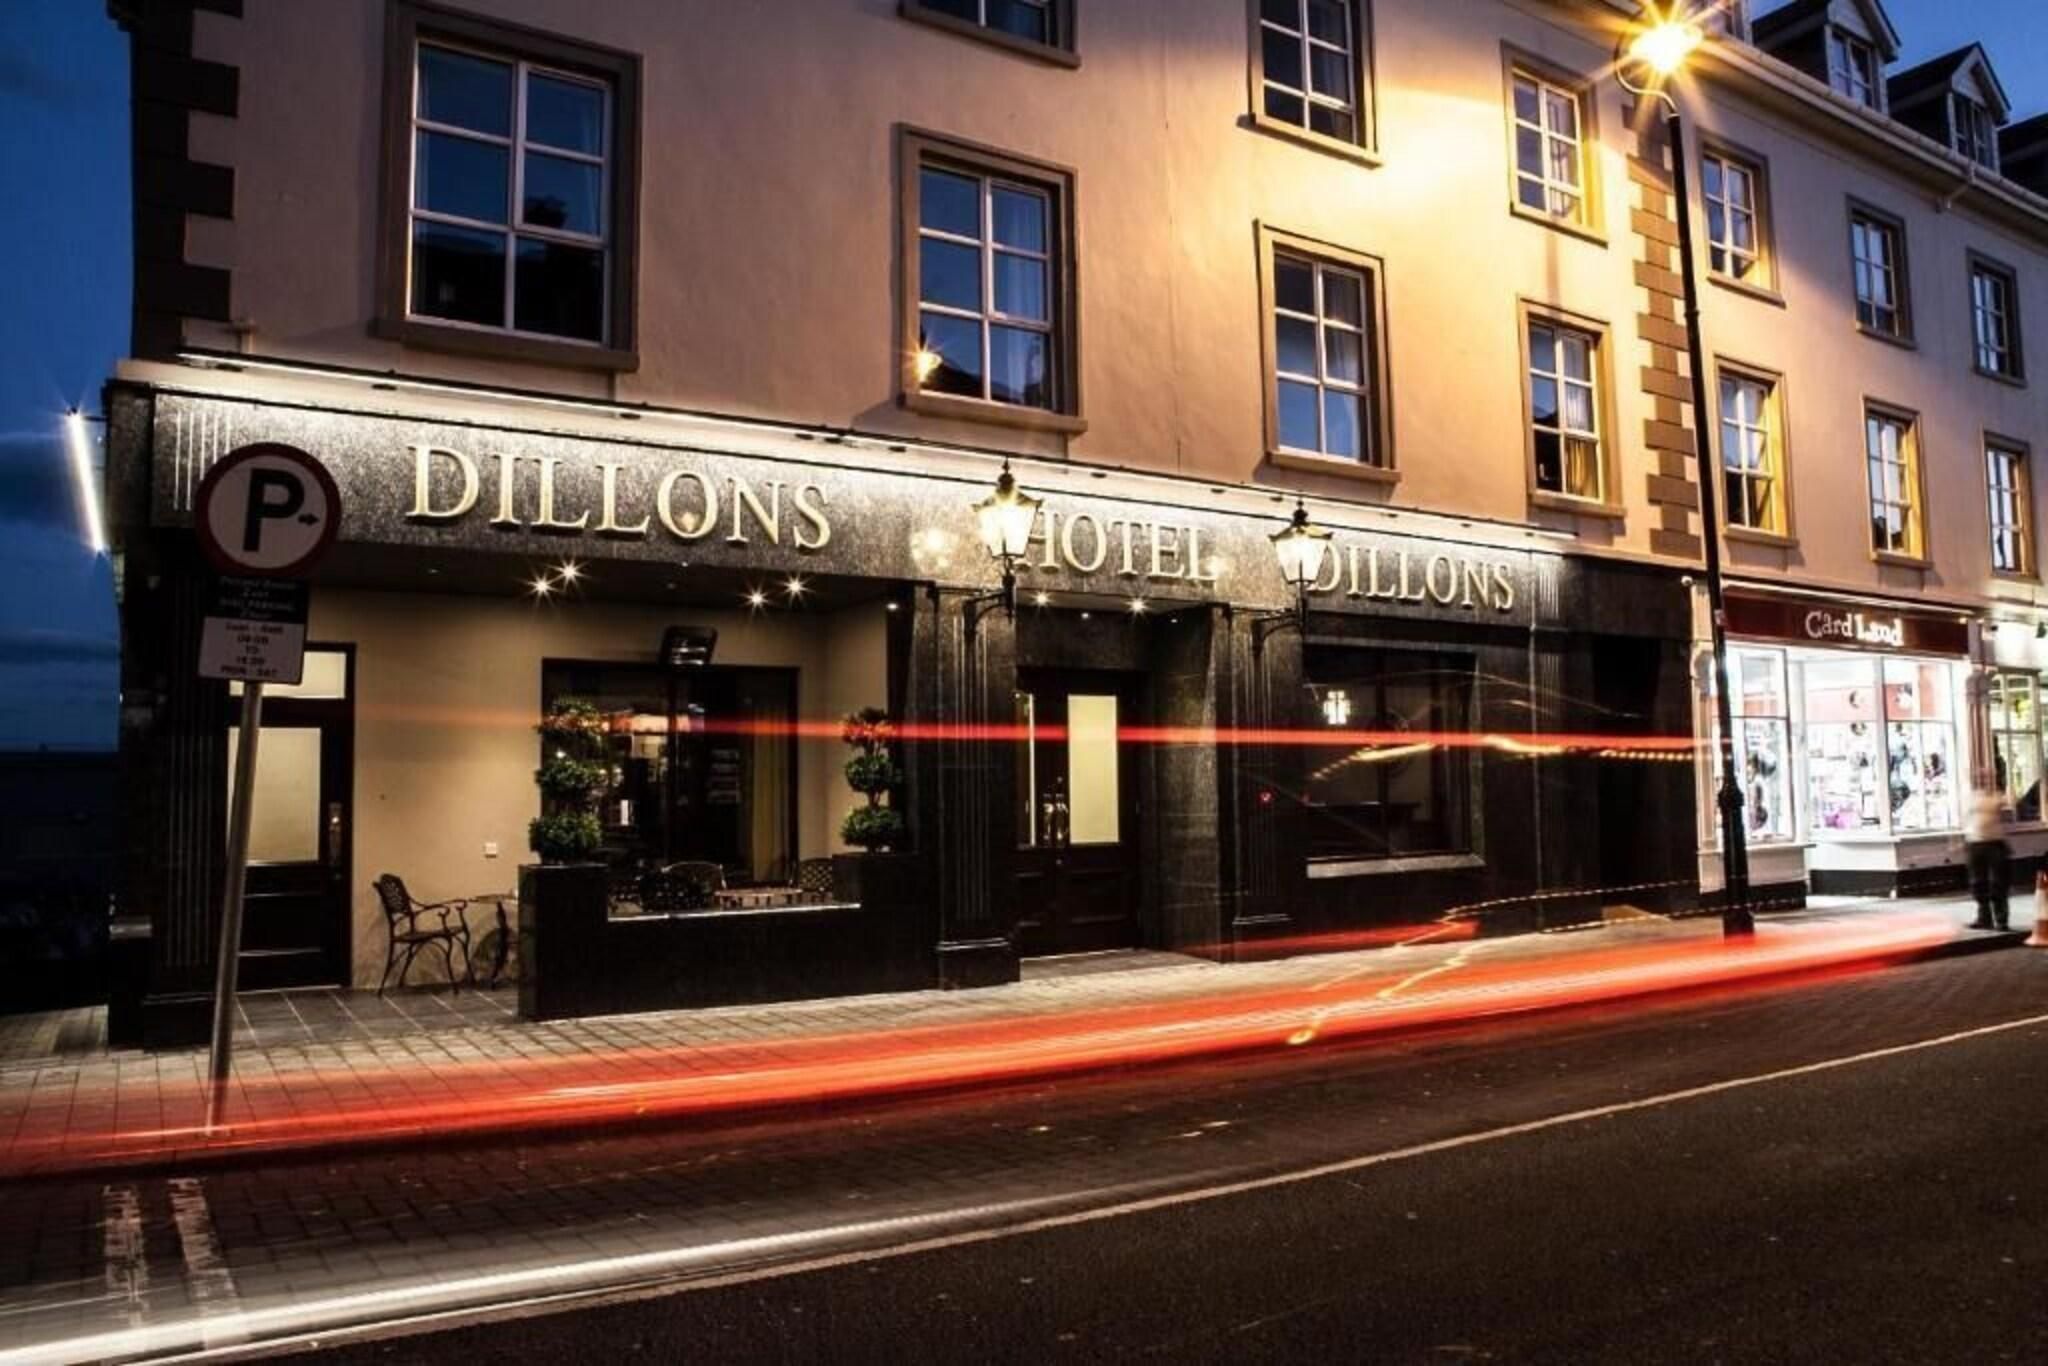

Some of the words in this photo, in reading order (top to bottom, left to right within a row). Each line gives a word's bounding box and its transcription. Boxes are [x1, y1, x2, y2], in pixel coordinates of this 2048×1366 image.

[242, 468, 306, 553] P
[405, 442, 832, 549] DILLONS
[1014, 507, 1217, 582] HOTEL
[1306, 541, 1514, 610] DILLONS
[1805, 610, 1854, 639] Card
